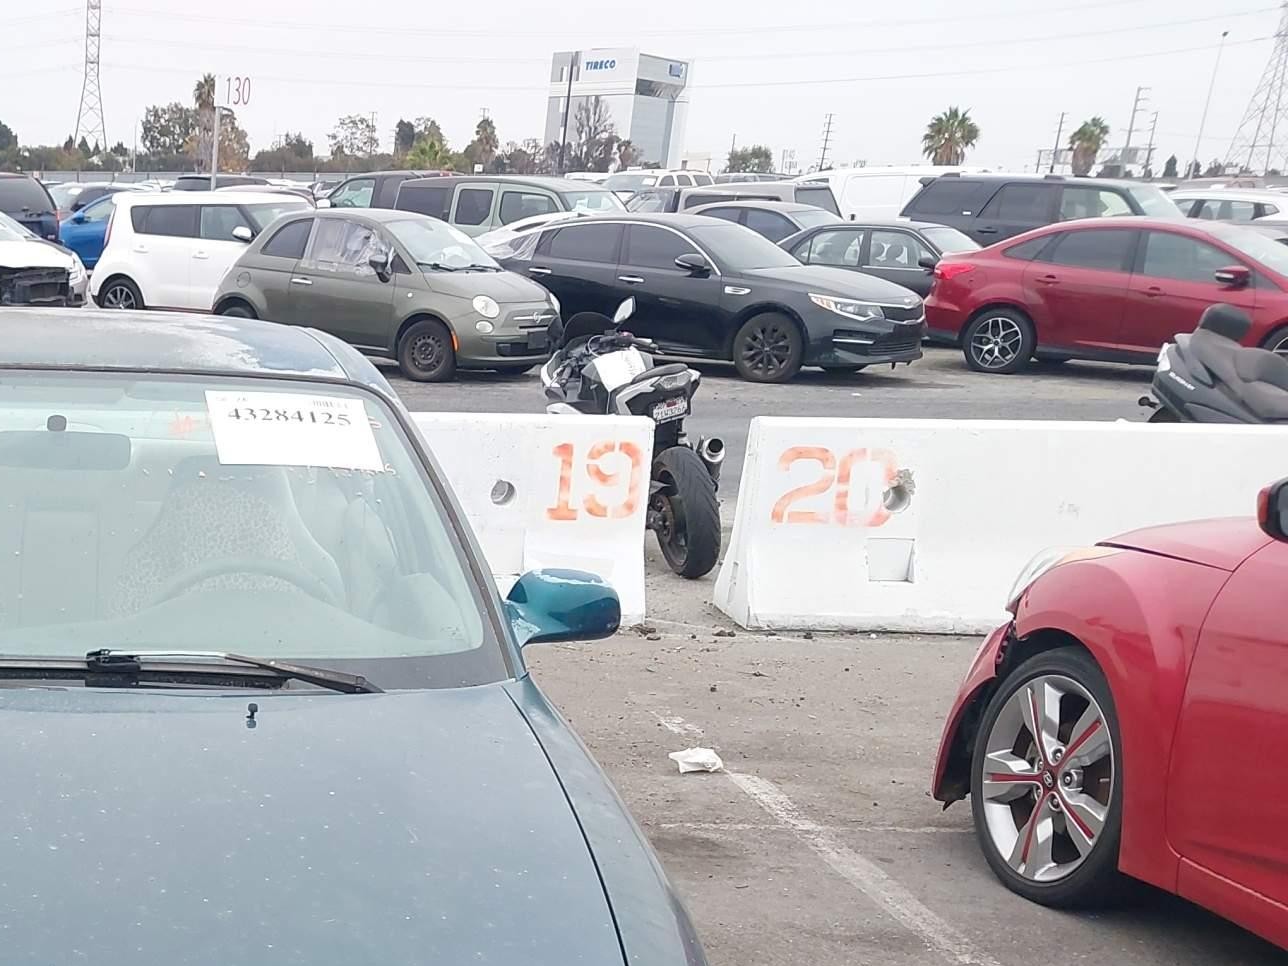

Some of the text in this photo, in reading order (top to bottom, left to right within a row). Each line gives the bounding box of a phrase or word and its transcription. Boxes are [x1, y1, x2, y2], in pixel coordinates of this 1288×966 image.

[585, 60, 616, 71] TIRECO
[225, 76, 252, 105] 130
[228, 407, 352, 427] 43284125
[545, 440, 644, 521] 19
[771, 446, 900, 528] 20
